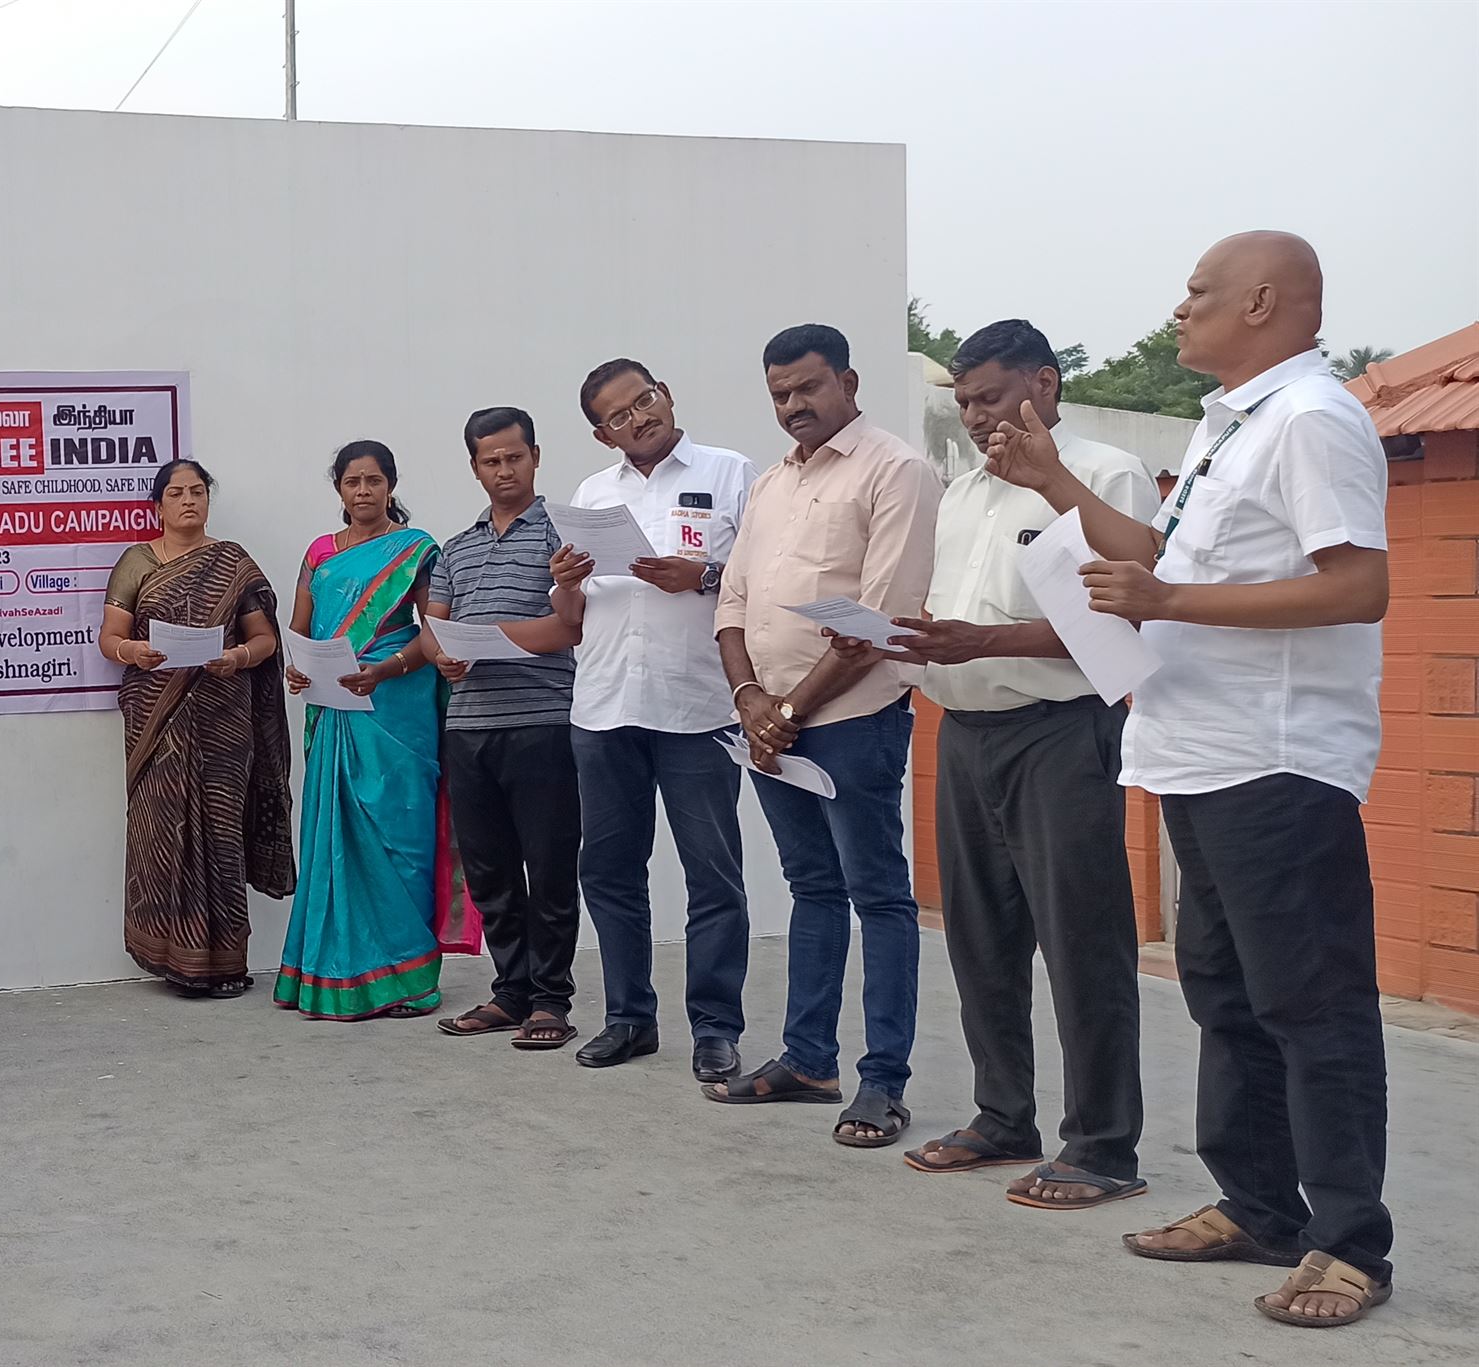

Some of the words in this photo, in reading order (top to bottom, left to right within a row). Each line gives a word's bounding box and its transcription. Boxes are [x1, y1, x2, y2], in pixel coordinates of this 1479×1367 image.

[53, 404, 135, 432] இந்தியா
[50, 436, 158, 465] INDIA
[2, 481, 32, 495] SAFE
[35, 479, 103, 495] CHILDHOOD,
[105, 478, 135, 493] SAFE
[30, 574, 70, 591] Village
